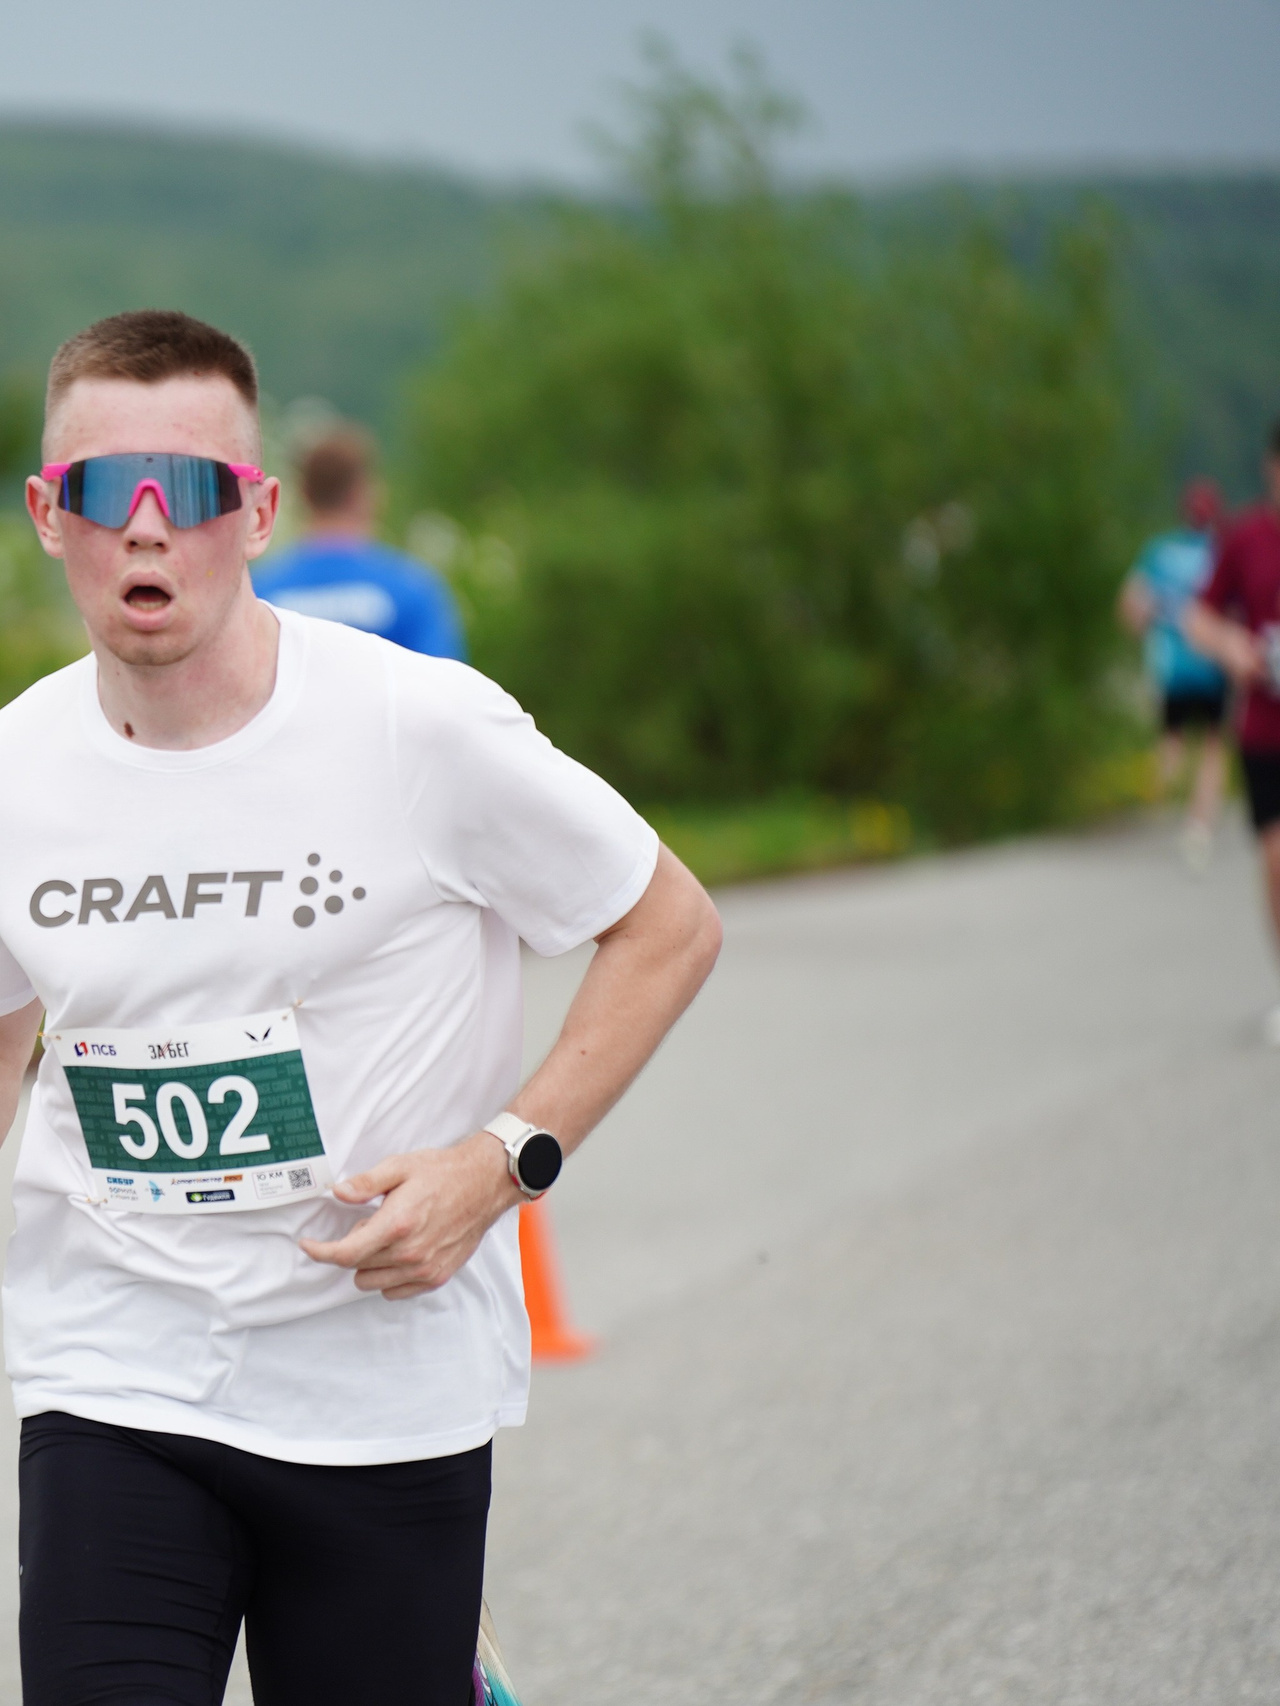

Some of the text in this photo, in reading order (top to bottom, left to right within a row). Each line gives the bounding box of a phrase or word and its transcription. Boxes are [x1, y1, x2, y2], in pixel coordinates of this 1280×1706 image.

[30, 871, 284, 928] CRAFT
[90, 1043, 117, 1057] ПСБ
[111, 1074, 271, 1161] 502
